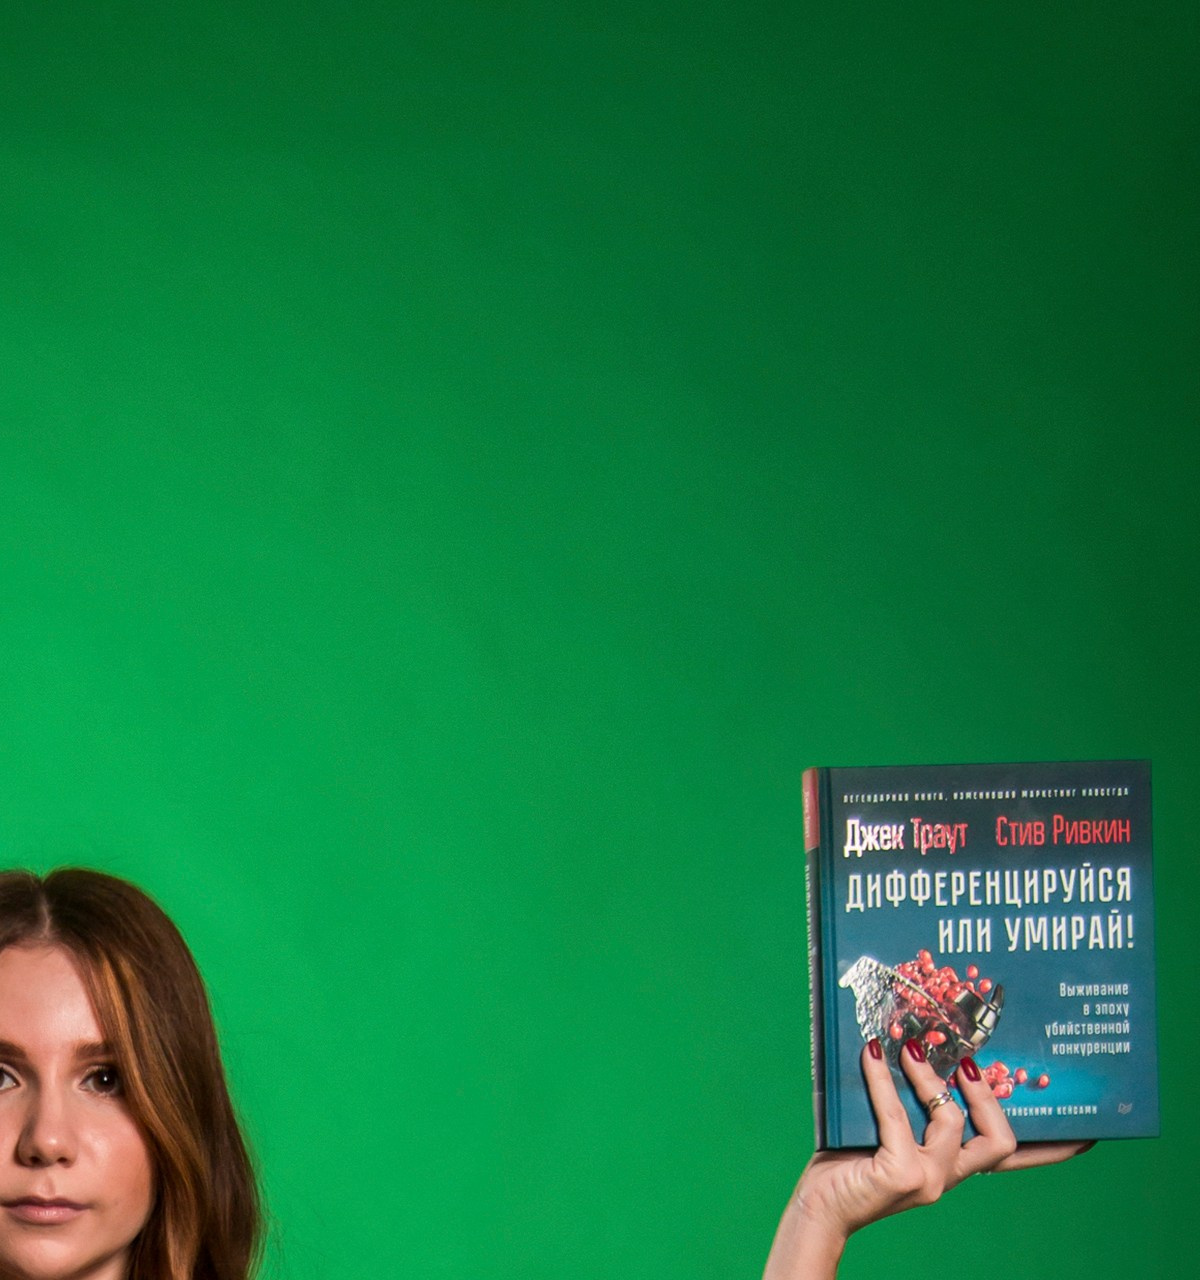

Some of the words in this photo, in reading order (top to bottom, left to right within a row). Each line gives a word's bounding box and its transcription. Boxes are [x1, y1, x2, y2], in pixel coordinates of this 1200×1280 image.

[844, 818, 904, 856] Джек
[911, 817, 968, 855] Траут
[996, 815, 1044, 846] Стив
[1053, 814, 1130, 845] Ривкин
[846, 863, 1131, 912] ДИФФЕРЕНЦИРУЙСЯ
[939, 917, 992, 953] ИЛИ
[1006, 909, 1134, 952] УМИРАЙ!
[1060, 982, 1128, 997] Выживание
[1083, 1003, 1090, 1016] в
[1095, 1003, 1129, 1019] эпоху
[1045, 1021, 1130, 1039] убийственной
[1052, 1041, 1130, 1058] конкуренции
[1003, 1106, 1053, 1116] ТАЙСКИМИ
